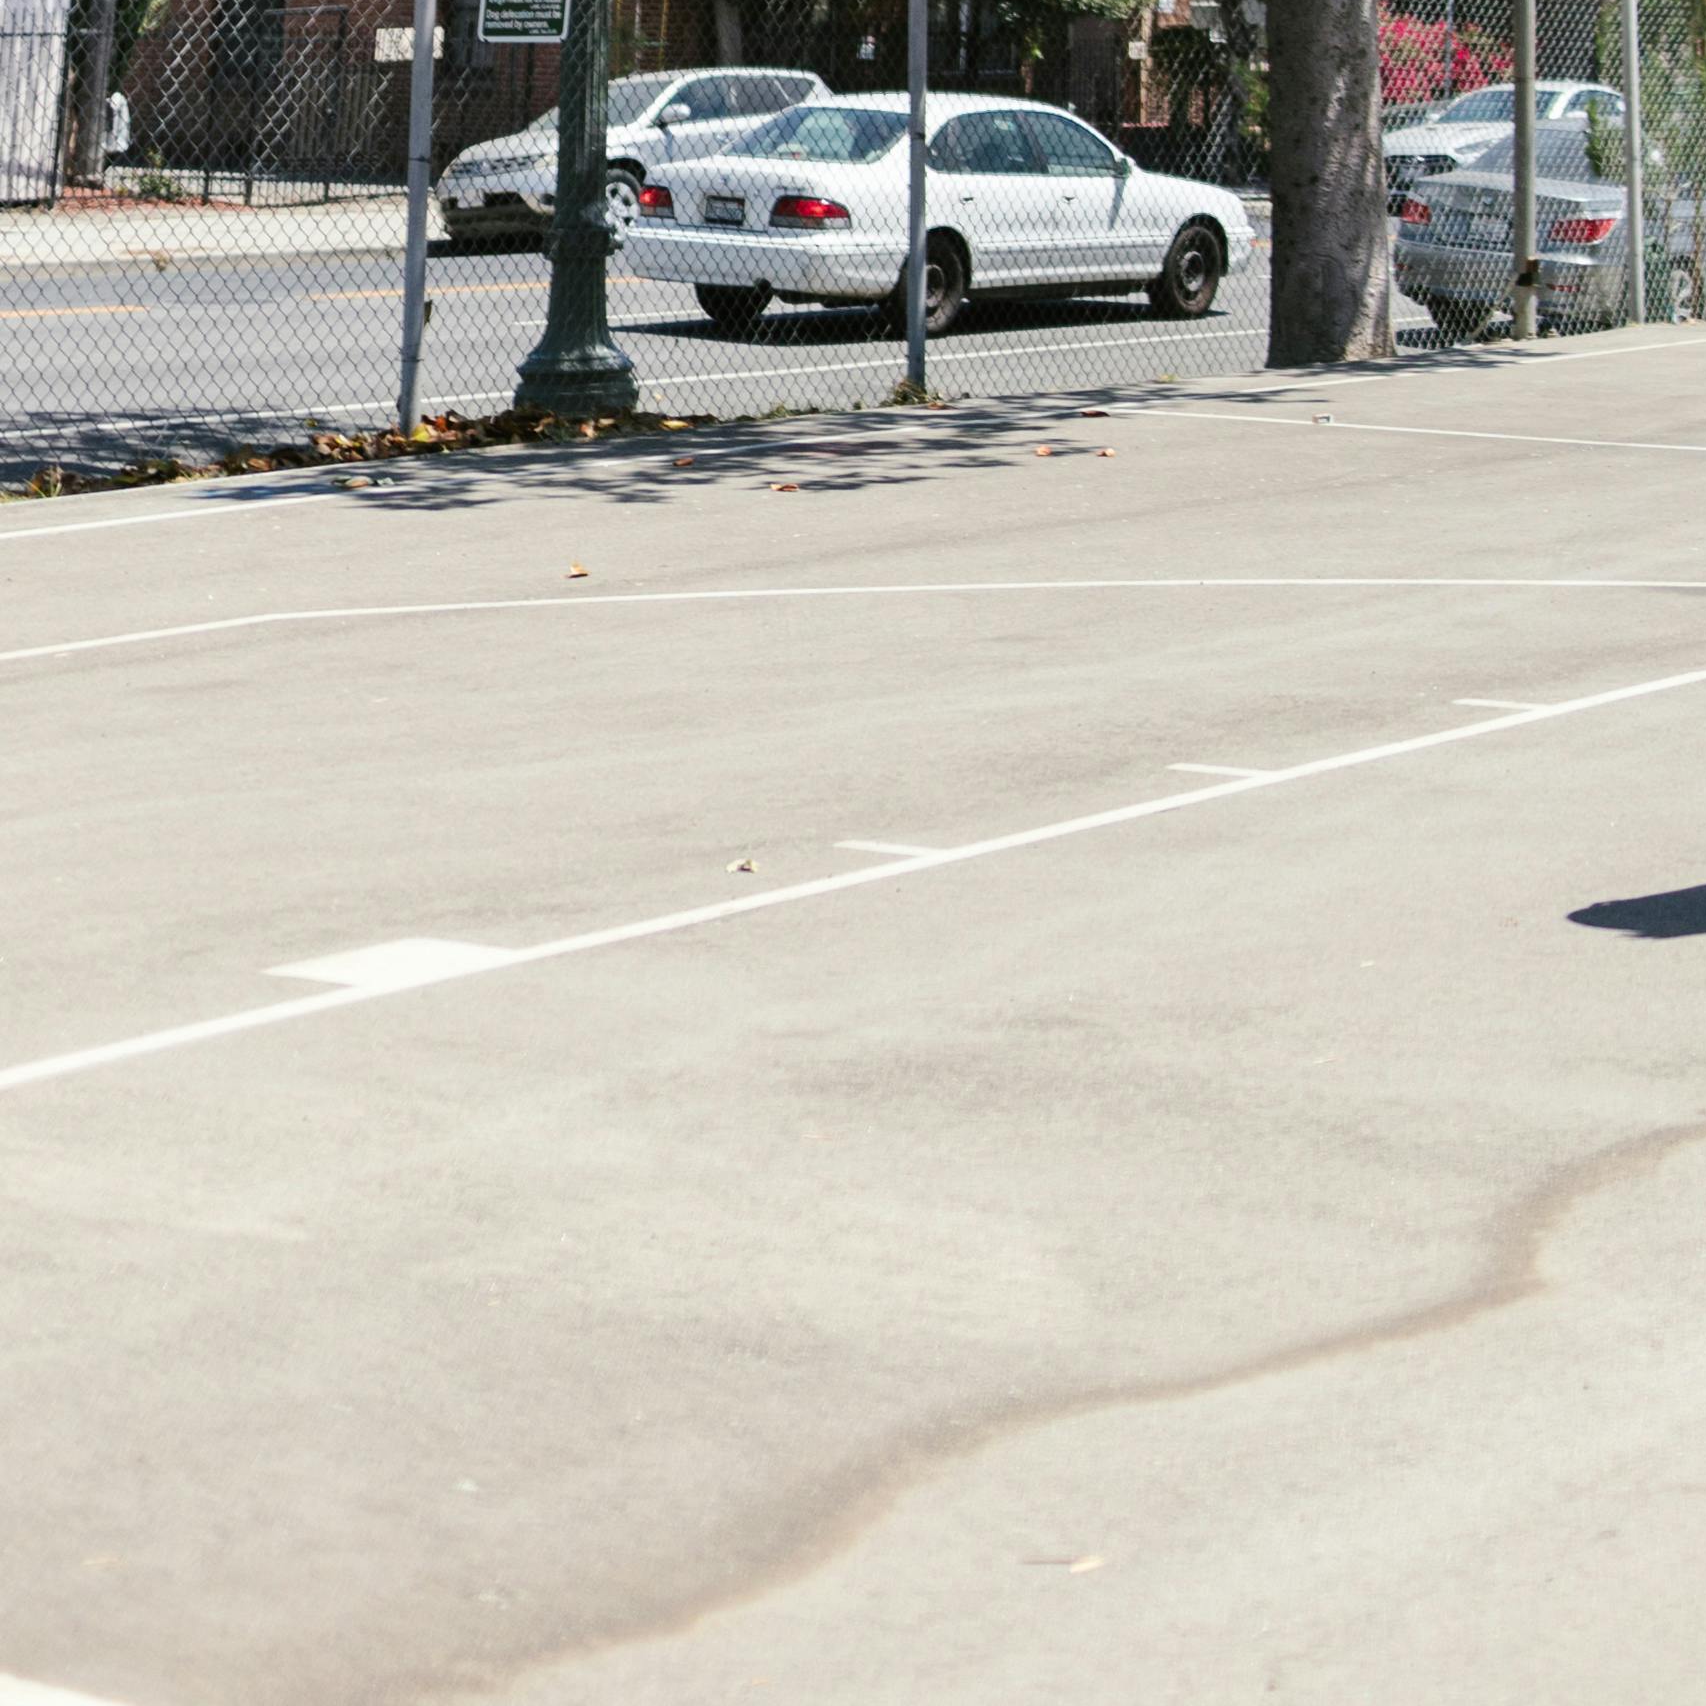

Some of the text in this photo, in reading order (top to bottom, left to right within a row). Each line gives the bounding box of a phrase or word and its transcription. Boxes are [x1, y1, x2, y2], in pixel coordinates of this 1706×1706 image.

[486, 9, 500, 20] Dog
[535, 11, 551, 19] must
[552, 10, 562, 19] be
[485, 20, 513, 28] removed
[513, 20, 522, 31] by
